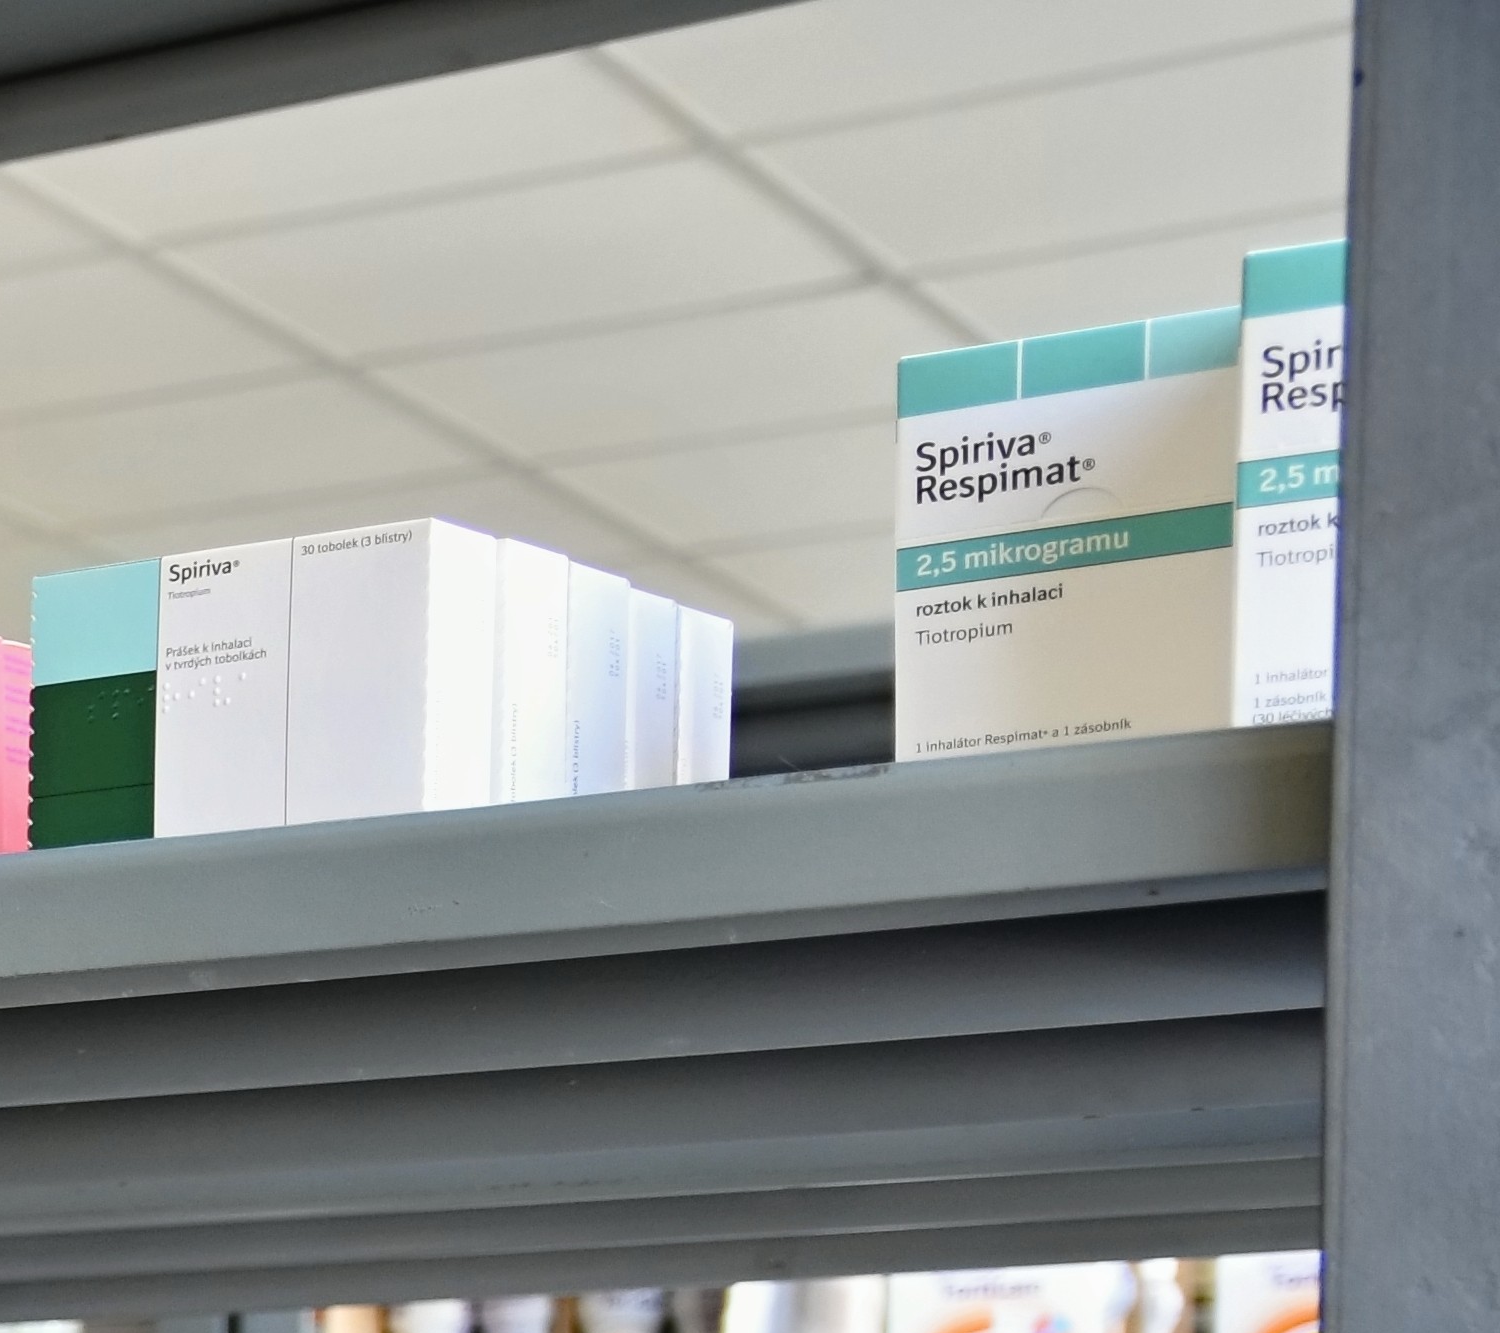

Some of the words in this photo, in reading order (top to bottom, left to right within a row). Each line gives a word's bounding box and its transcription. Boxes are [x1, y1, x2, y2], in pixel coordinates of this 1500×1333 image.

[1260, 463, 1304, 493] 2,5
[1258, 516, 1321, 537] roztok
[301, 545, 315, 556] 30
[318, 539, 358, 553] tobolek
[361, 536, 372, 548] (3
[375, 530, 412, 545] blistry)
[916, 550, 956, 578] 2,5
[964, 531, 1130, 570] mikrogramu
[916, 596, 972, 617] roztok
[978, 594, 986, 609] k
[992, 583, 1063, 607] inhalaci
[916, 622, 1013, 645] Tiotropium
[165, 642, 200, 657] Prášek
[202, 642, 208, 651] k
[211, 637, 252, 650] inhalaci
[165, 661, 171, 670] v
[174, 657, 212, 670] tvrdých
[215, 649, 267, 665] tobolkách
[916, 743, 922, 754] 1
[926, 734, 981, 753] inhalátor
[1052, 728, 1059, 738] a
[1063, 726, 1069, 736] 1
[1074, 718, 1131, 736] zásobník
